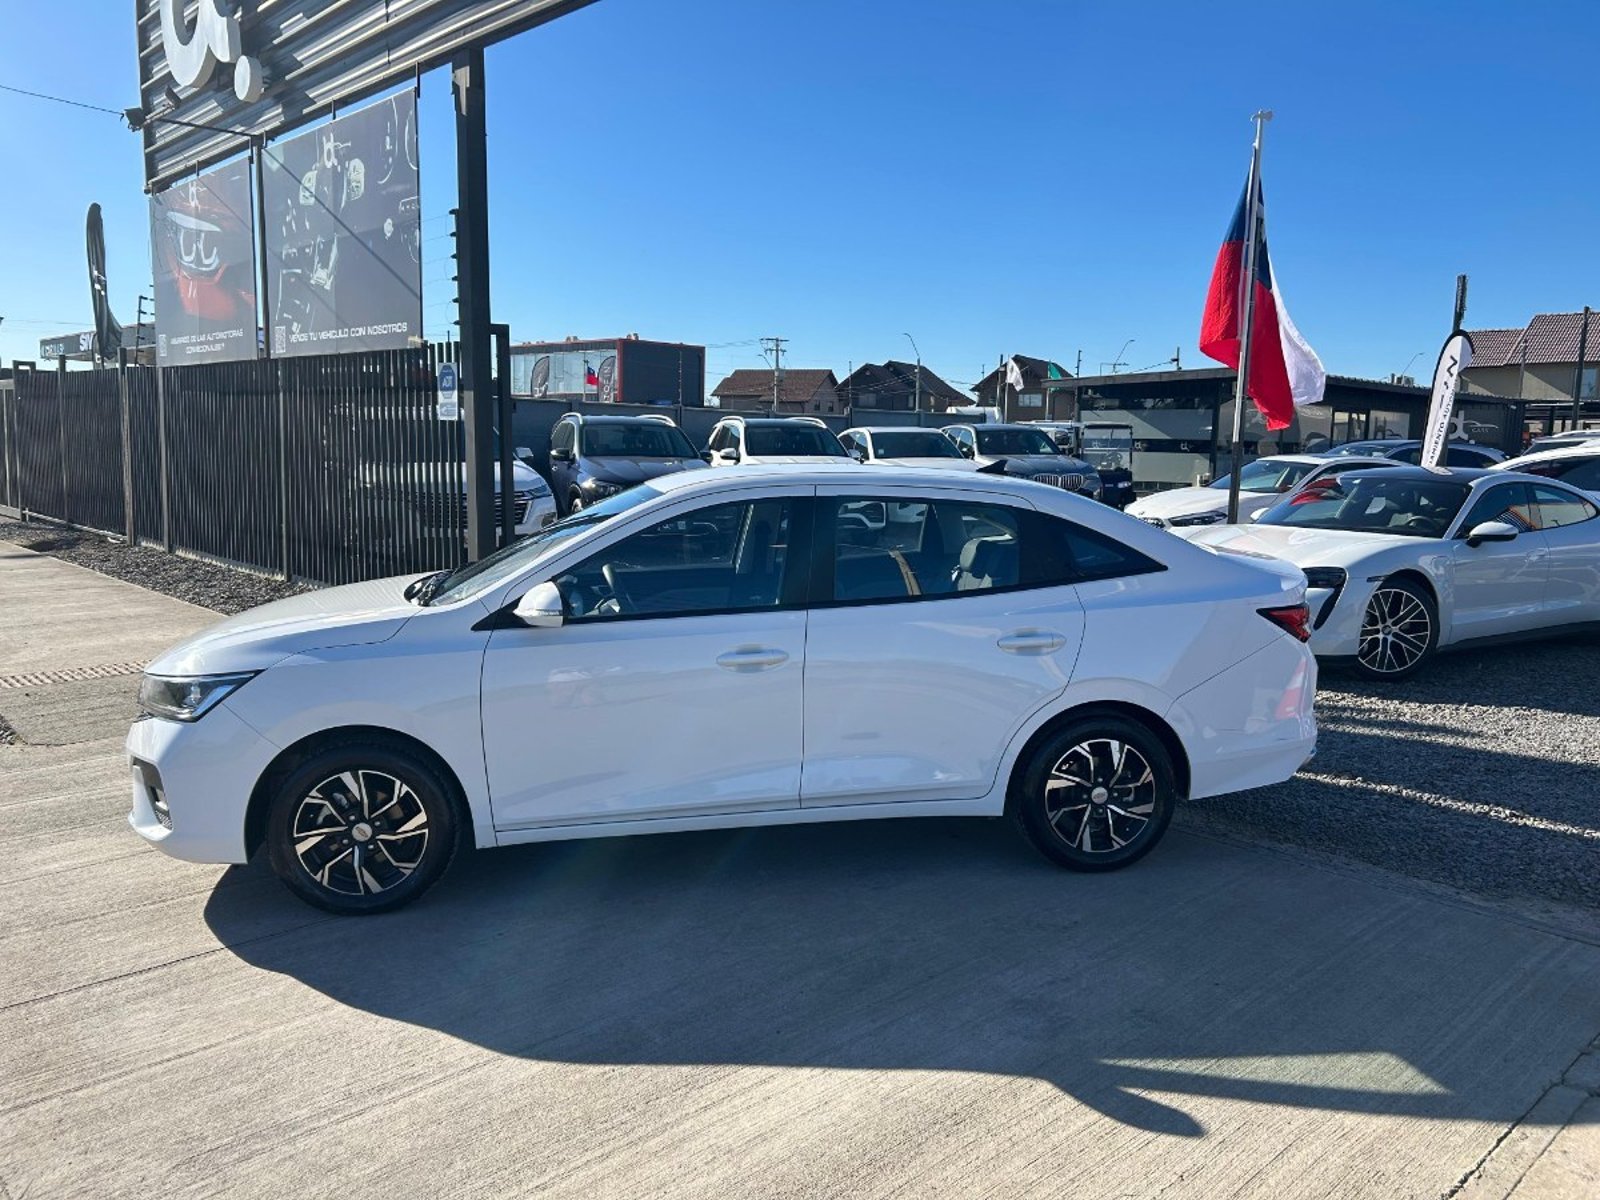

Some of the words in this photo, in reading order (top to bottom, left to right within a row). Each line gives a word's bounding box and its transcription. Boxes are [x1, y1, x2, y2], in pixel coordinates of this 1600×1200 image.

[310, 332, 317, 340] TU
[350, 327, 365, 336] CON
[367, 322, 408, 335] NOSOTROS
